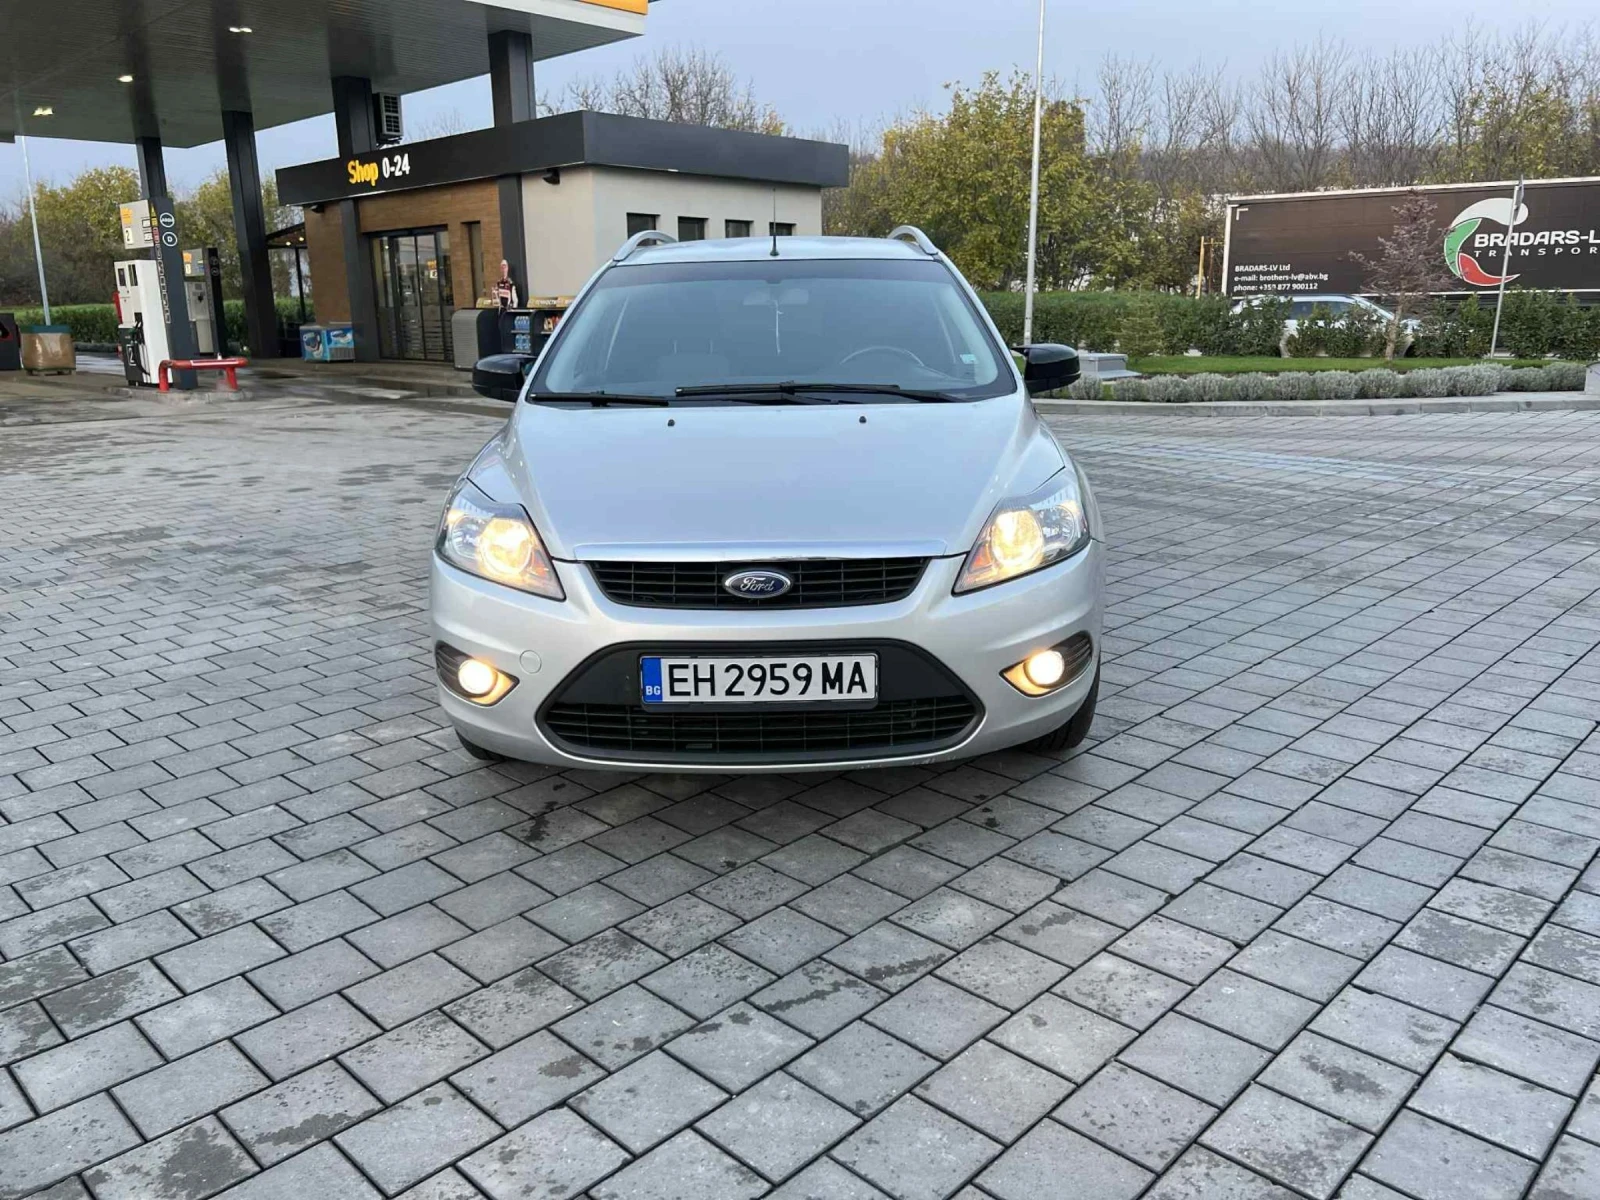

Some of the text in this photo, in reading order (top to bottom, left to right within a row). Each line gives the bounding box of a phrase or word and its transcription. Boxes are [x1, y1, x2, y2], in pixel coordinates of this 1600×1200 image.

[347, 153, 411, 187] Shop 0-24
[1234, 284, 1258, 292] phone:
[1291, 282, 1318, 290] 900112
[740, 576, 775, 592] Ford
[645, 661, 868, 697] BG EH 2959 MA
